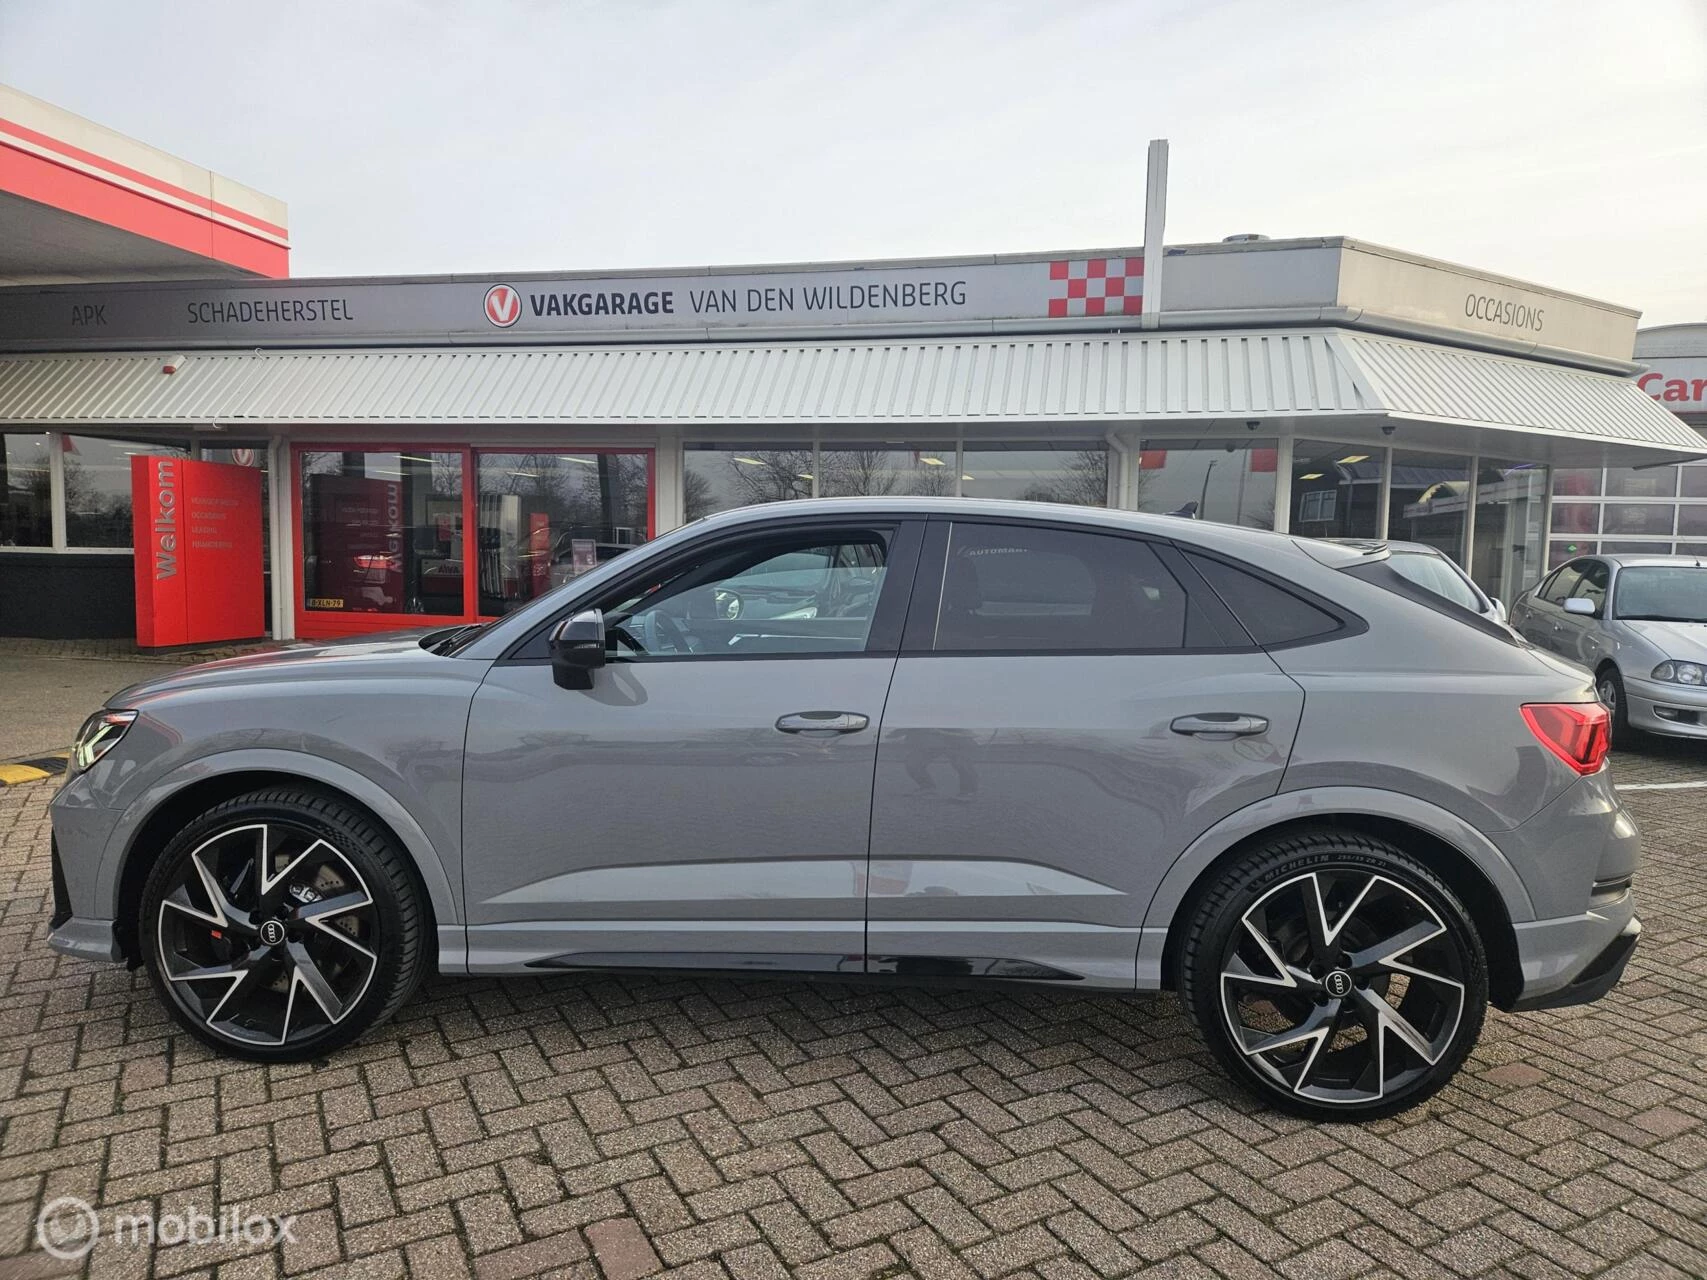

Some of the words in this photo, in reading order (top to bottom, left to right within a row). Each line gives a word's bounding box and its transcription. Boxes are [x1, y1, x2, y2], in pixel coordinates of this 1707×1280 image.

[71, 303, 107, 326] APK
[187, 299, 354, 324] SCHADEHERSTEL
[530, 291, 675, 317] VAKGARAGE
[689, 289, 737, 314] VAN
[747, 287, 794, 312] DEN
[803, 281, 967, 311] WILDENBERG
[1465, 293, 1545, 332] OCCASIONS
[155, 461, 177, 580] Welkom
[1265, 854, 1329, 882] MICHELIN
